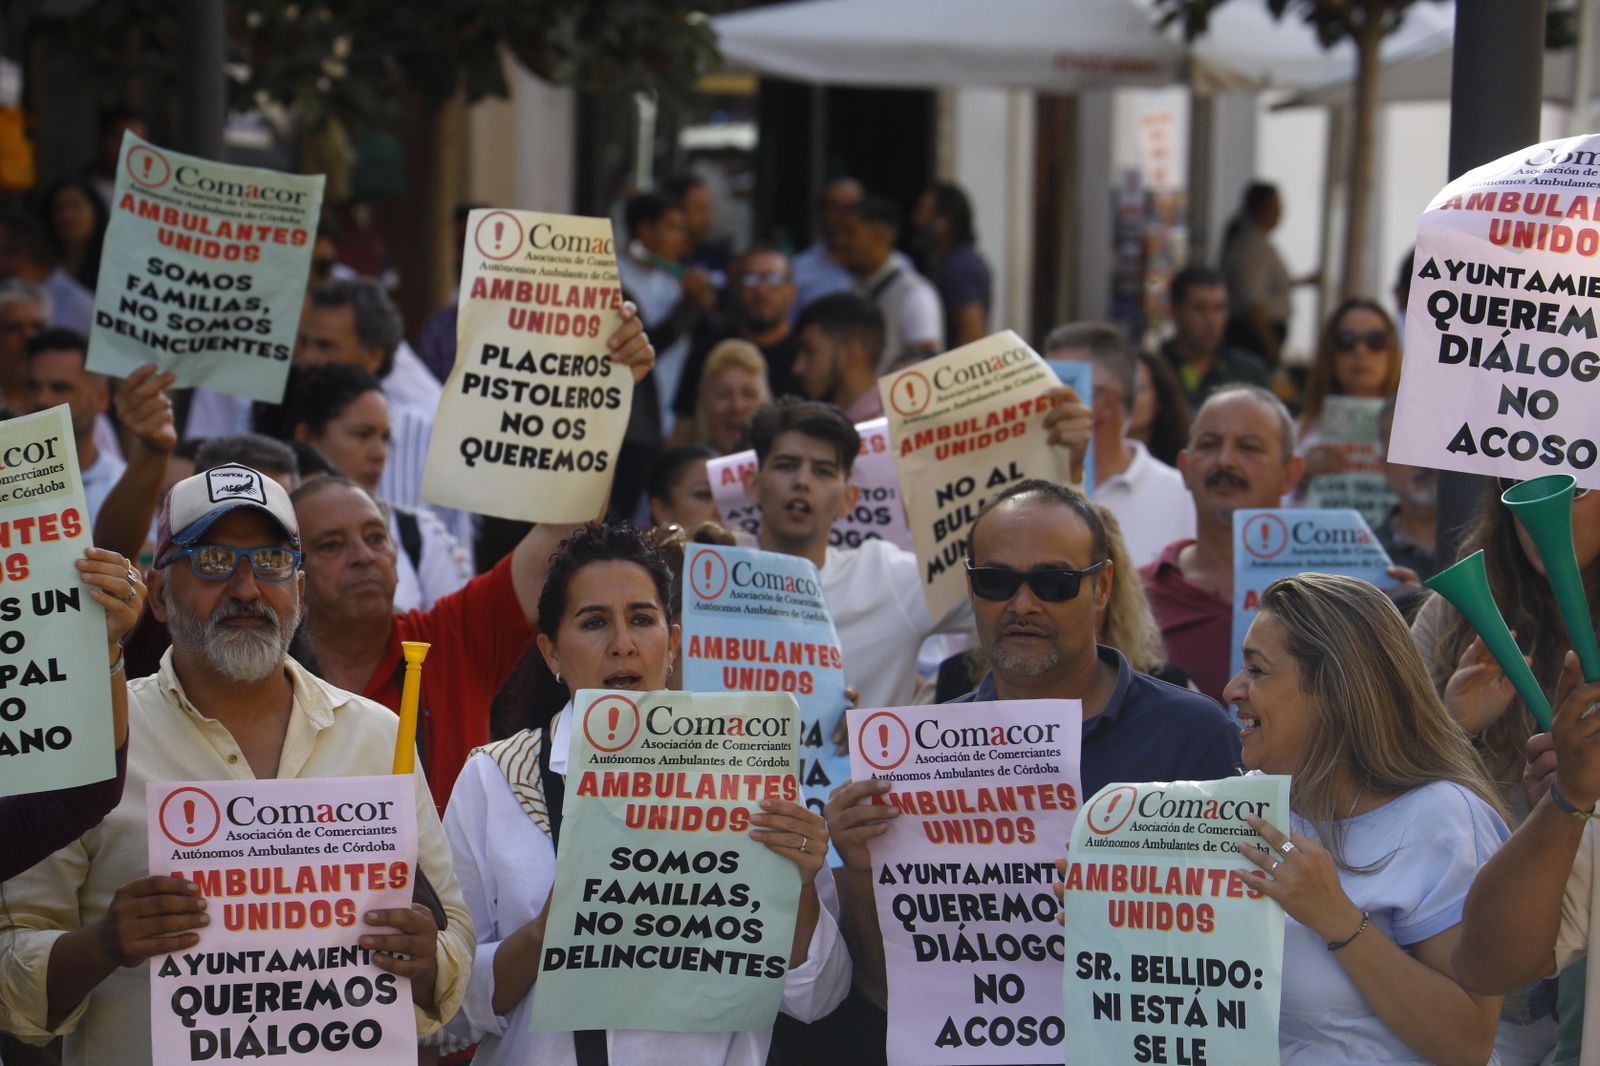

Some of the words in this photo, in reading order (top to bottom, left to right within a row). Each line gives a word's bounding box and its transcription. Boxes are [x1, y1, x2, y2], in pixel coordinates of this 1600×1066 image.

[174, 164, 308, 206] Comacor
[1513, 166, 1580, 177] Asociación
[1582, 167, 1600, 177] de
[1529, 177, 1600, 189] Ambulantes
[119, 192, 309, 247] AMBULANTES
[157, 228, 261, 262] UNIDOS
[147, 256, 252, 292] SOMOS
[126, 274, 270, 315] FAMILIAS,
[119, 296, 158, 323] NO
[166, 313, 273, 335] SOMOS
[508, 308, 602, 338] UNIDOS
[95, 309, 291, 362] DELINCUENTES
[480, 343, 611, 377] PLACEROS
[461, 372, 621, 410] PISTOLEROS
[1497, 383, 1560, 421] NO
[500, 410, 544, 437] NO
[552, 417, 586, 441] OS
[935, 422, 1026, 461] UNIDOS
[0, 436, 58, 470] cor
[460, 437, 608, 473] QUEREMOS
[1446, 421, 1598, 470] ACOSO
[12, 479, 66, 500] Córdoba
[935, 475, 976, 510] NO
[985, 461, 1024, 488] AL
[932, 498, 985, 543] BUL
[731, 560, 821, 597] Comaco
[31, 587, 81, 616] UN
[688, 634, 843, 670] AMBULANTES
[722, 666, 815, 695] UNIDOS
[645, 705, 791, 737] Comacor
[915, 718, 1060, 750] Comacor
[588, 752, 656, 766] Autónomos
[658, 753, 726, 767] Ambulantes
[728, 755, 743, 767] de
[746, 755, 790, 768] Córdoba
[640, 737, 702, 751] Asociación
[704, 738, 719, 750] de
[722, 739, 792, 752] Comerciantes
[914, 751, 971, 765] Asociación
[973, 750, 987, 762] de
[989, 747, 1062, 761] Comerciantes
[576, 770, 798, 803] AMBULANTES
[871, 770, 931, 782] Autónomos
[934, 766, 996, 780] Ambulantes
[997, 765, 1011, 777] de
[1012, 763, 1060, 776] Córdoba
[226, 796, 394, 827] Comacor
[625, 804, 750, 832] UNIDOS
[1137, 790, 1270, 821] Comacor
[225, 828, 293, 842] Asociación
[295, 827, 311, 839] de
[314, 824, 398, 838] Comerciantes
[922, 817, 1037, 844] UNIDOS
[1085, 836, 1141, 849] Autónomos
[1142, 838, 1201, 852] Ambulantes
[1202, 841, 1219, 853] de
[1220, 841, 1270, 855] Cóba
[1129, 821, 1181, 834] Asociación
[1182, 822, 1196, 834] de
[1197, 823, 1264, 837] Comercian
[171, 847, 244, 861] Autónomos
[247, 844, 321, 858] Ambulantes
[323, 843, 339, 855] de
[342, 840, 396, 853] Córdoba
[609, 846, 740, 876] SOMOS
[878, 863, 1064, 885] AYUNTAMIENT
[1065, 863, 1267, 900] AMBULANTES
[582, 878, 761, 914] FAMILIAS,
[892, 893, 1064, 932] QUEREMO
[223, 898, 357, 932] UNIDOS
[573, 911, 623, 937] NO
[633, 912, 764, 944] SOMOS
[1108, 899, 1216, 934] UNIDOS
[158, 944, 404, 979] AYUNTAMIENT
[542, 944, 787, 979] DELINCUENTES
[1075, 951, 1121, 982] SR.
[1130, 953, 1263, 990] BELLIDO:
[171, 972, 398, 1028] QUEREMOS
[974, 973, 1026, 1005] NO
[1092, 991, 1122, 1022] NI
[1130, 986, 1209, 1029] ESTÁ
[1216, 998, 1246, 1030] NI
[190, 1014, 382, 1062] DIÁLOGO
[935, 1014, 1065, 1049] ACOSO
[1133, 1034, 1168, 1064] SE
[1176, 1037, 1207, 1066] LE
